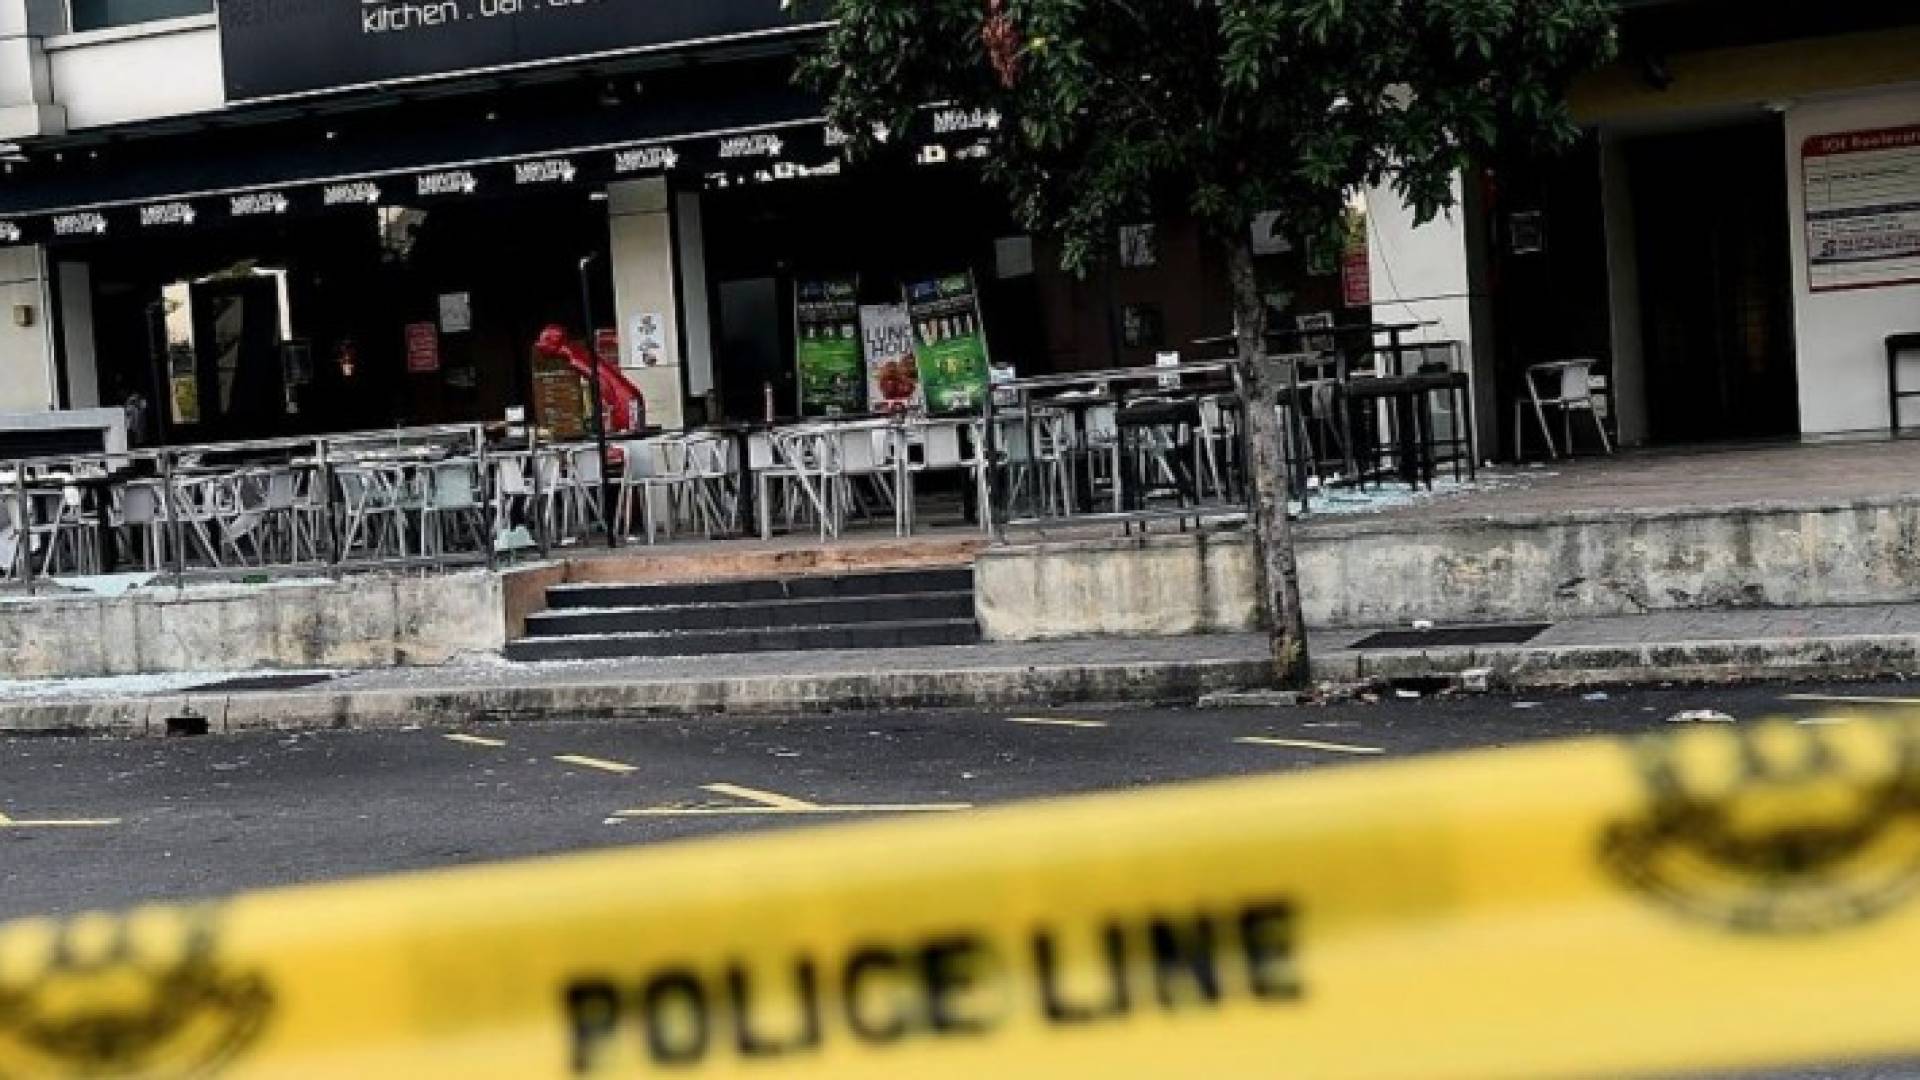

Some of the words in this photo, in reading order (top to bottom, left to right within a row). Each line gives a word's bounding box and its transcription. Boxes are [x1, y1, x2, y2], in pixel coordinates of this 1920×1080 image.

[362, 1, 460, 33] kitchen
[560, 930, 988, 1075] POLICE
[1031, 900, 1303, 1024] LINE
